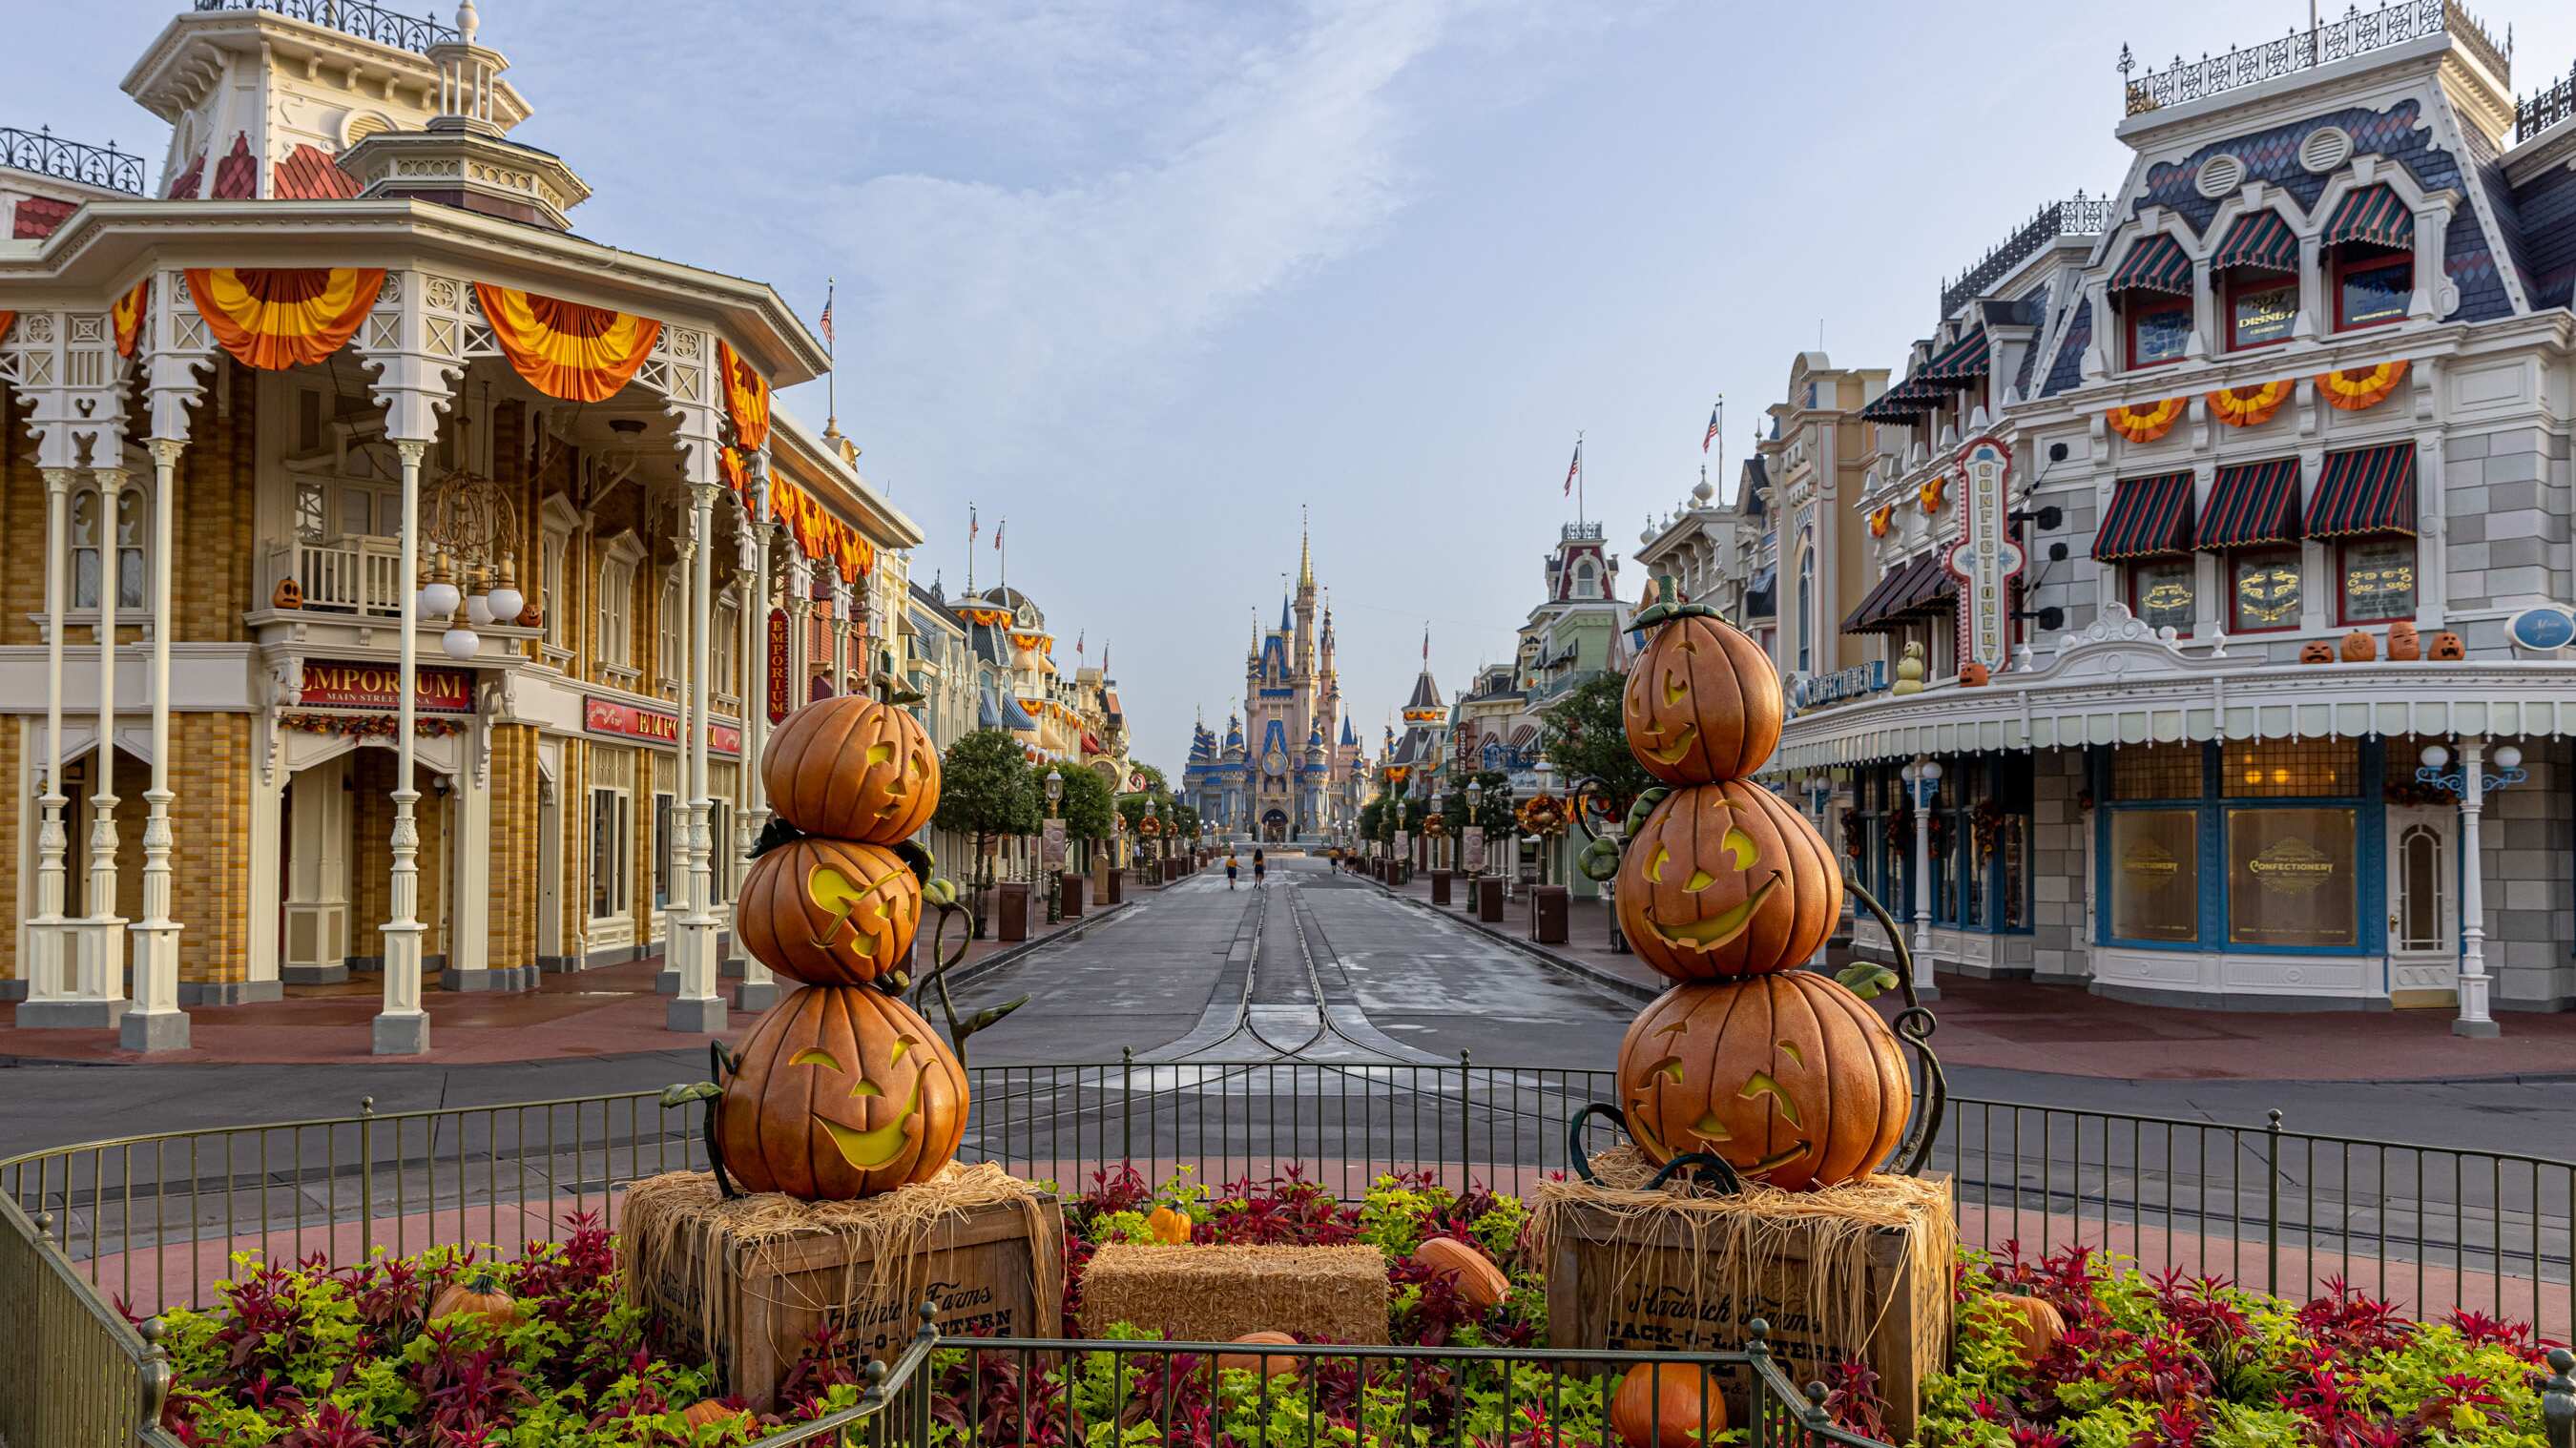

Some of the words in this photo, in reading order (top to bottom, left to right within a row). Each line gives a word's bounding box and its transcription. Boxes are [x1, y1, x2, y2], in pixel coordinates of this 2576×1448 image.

[2239, 310, 2296, 328] DISNEY
[1979, 463, 1996, 661] CONFECTIONERY
[301, 667, 461, 698] EMPORUM
[771, 620, 783, 714] EMPORIUM
[326, 692, 358, 702] MAIN
[2250, 860, 2334, 874] CONFECTIONERY
[925, 1281, 992, 1312] Farms
